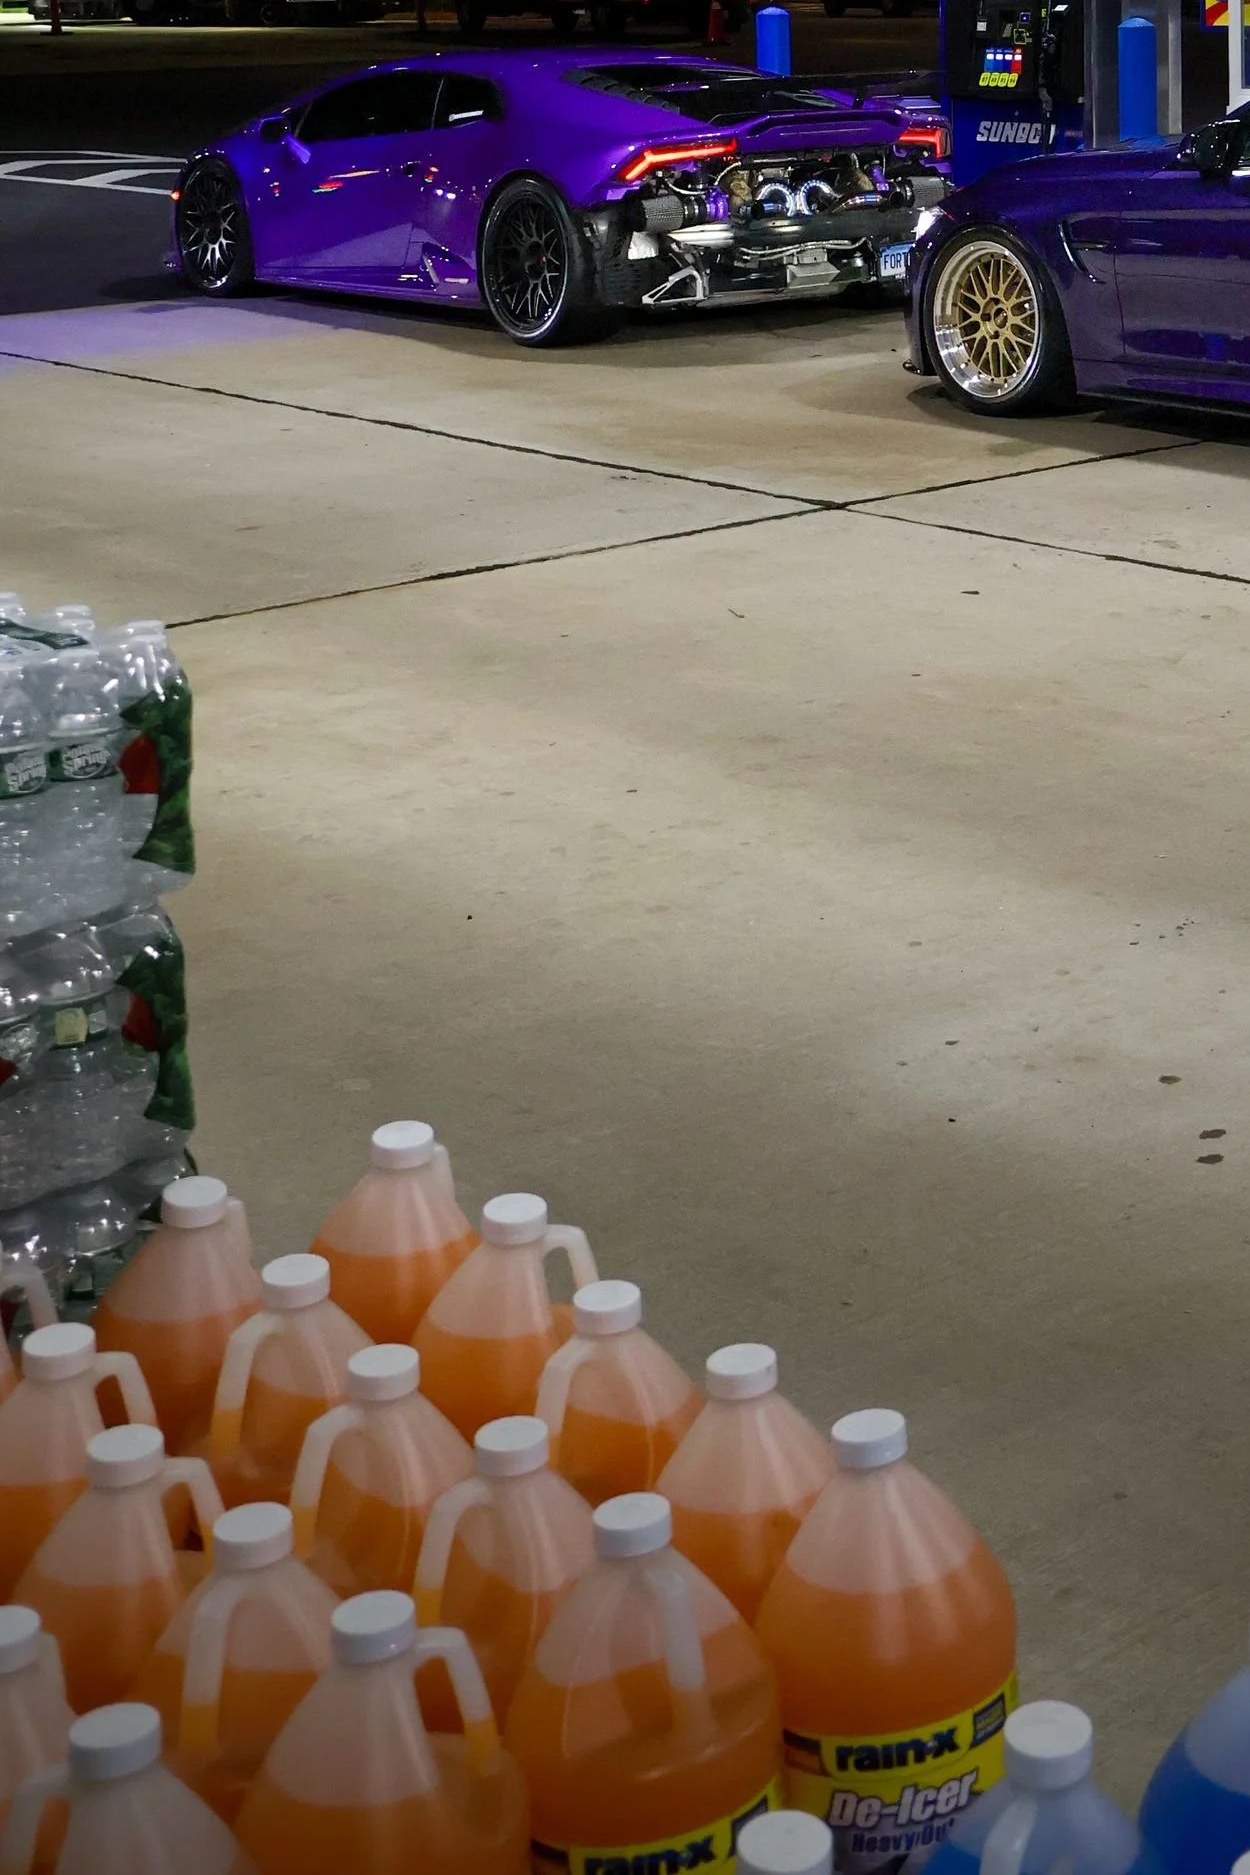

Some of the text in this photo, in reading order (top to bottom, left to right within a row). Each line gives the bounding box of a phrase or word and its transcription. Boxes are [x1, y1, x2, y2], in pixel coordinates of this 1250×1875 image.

[836, 1726, 959, 1771] rain-x
[829, 1769, 979, 1828] De-Icer
[851, 1827, 916, 1853] Heavy
